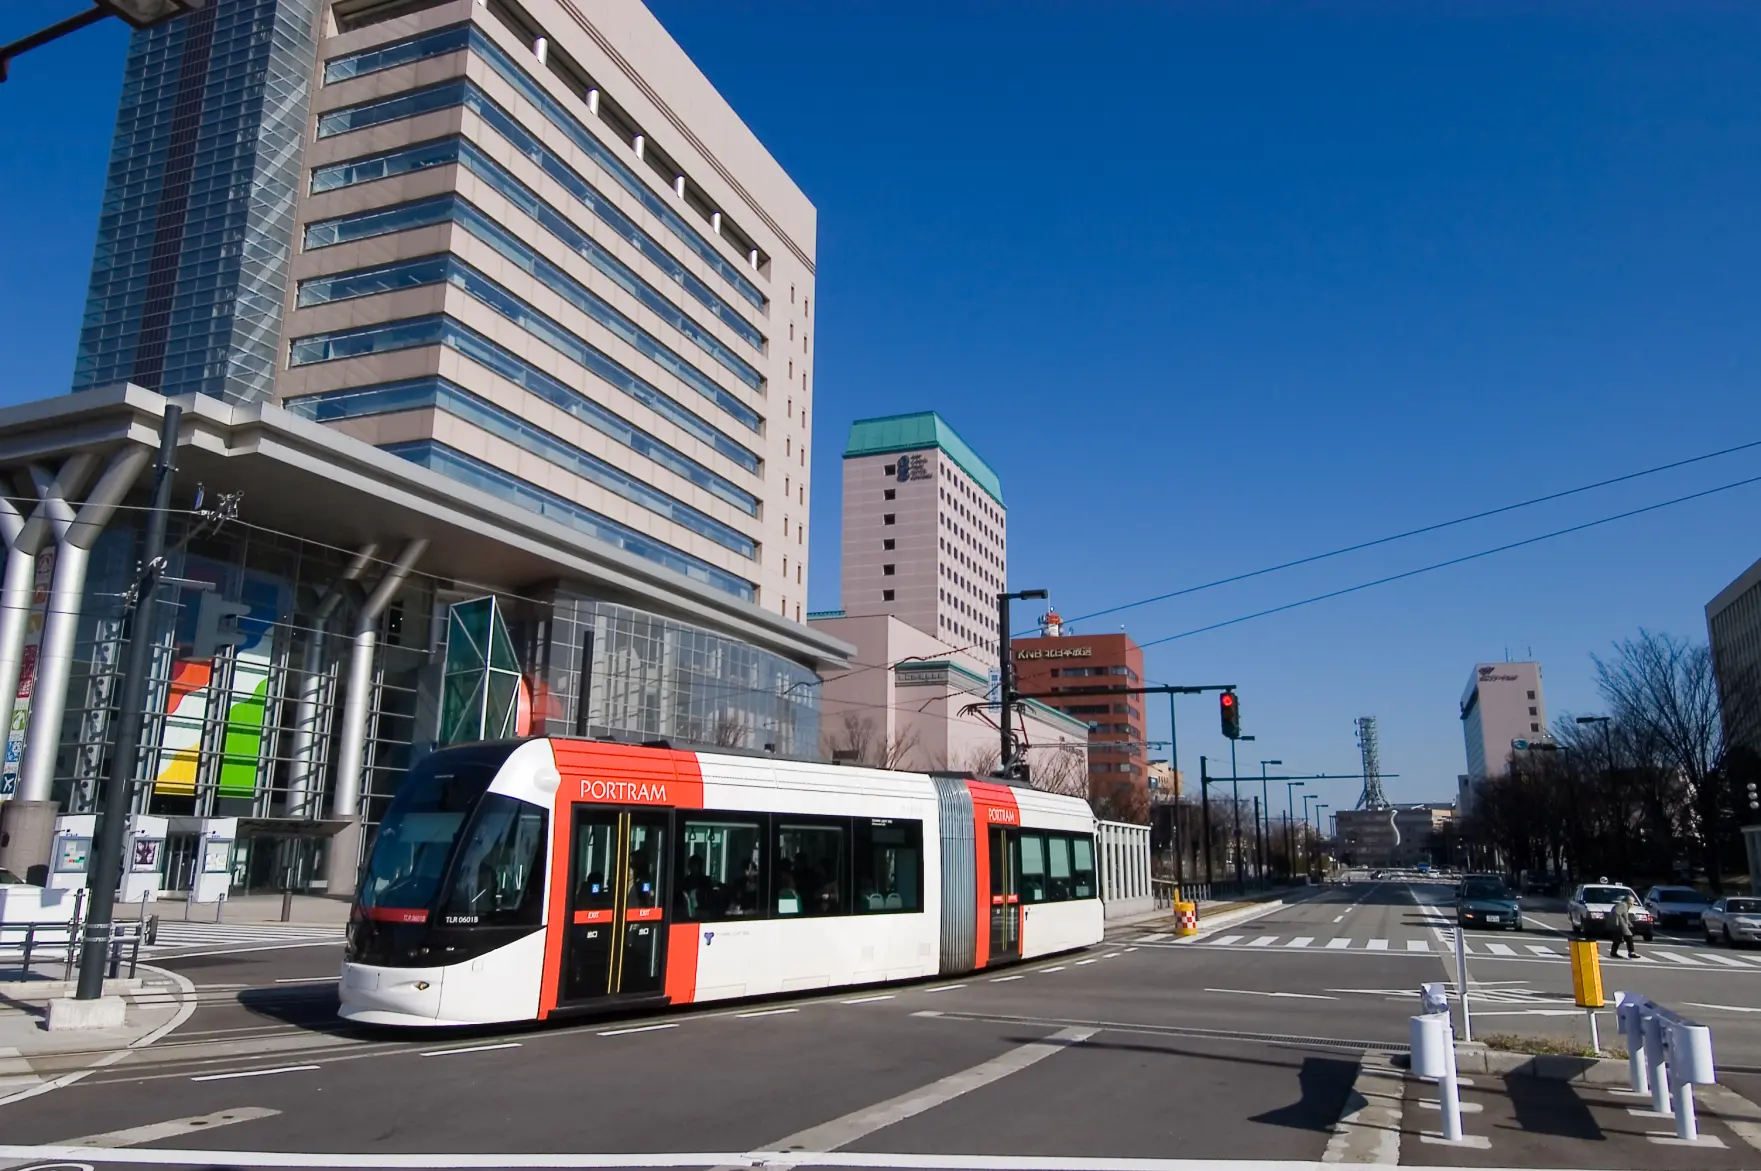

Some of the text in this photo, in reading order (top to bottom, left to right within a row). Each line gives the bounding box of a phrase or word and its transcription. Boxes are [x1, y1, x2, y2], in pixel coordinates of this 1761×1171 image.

[1017, 649, 1042, 659] KNB
[580, 779, 667, 802] PORTRAM
[988, 807, 1015, 822] PORTRAM
